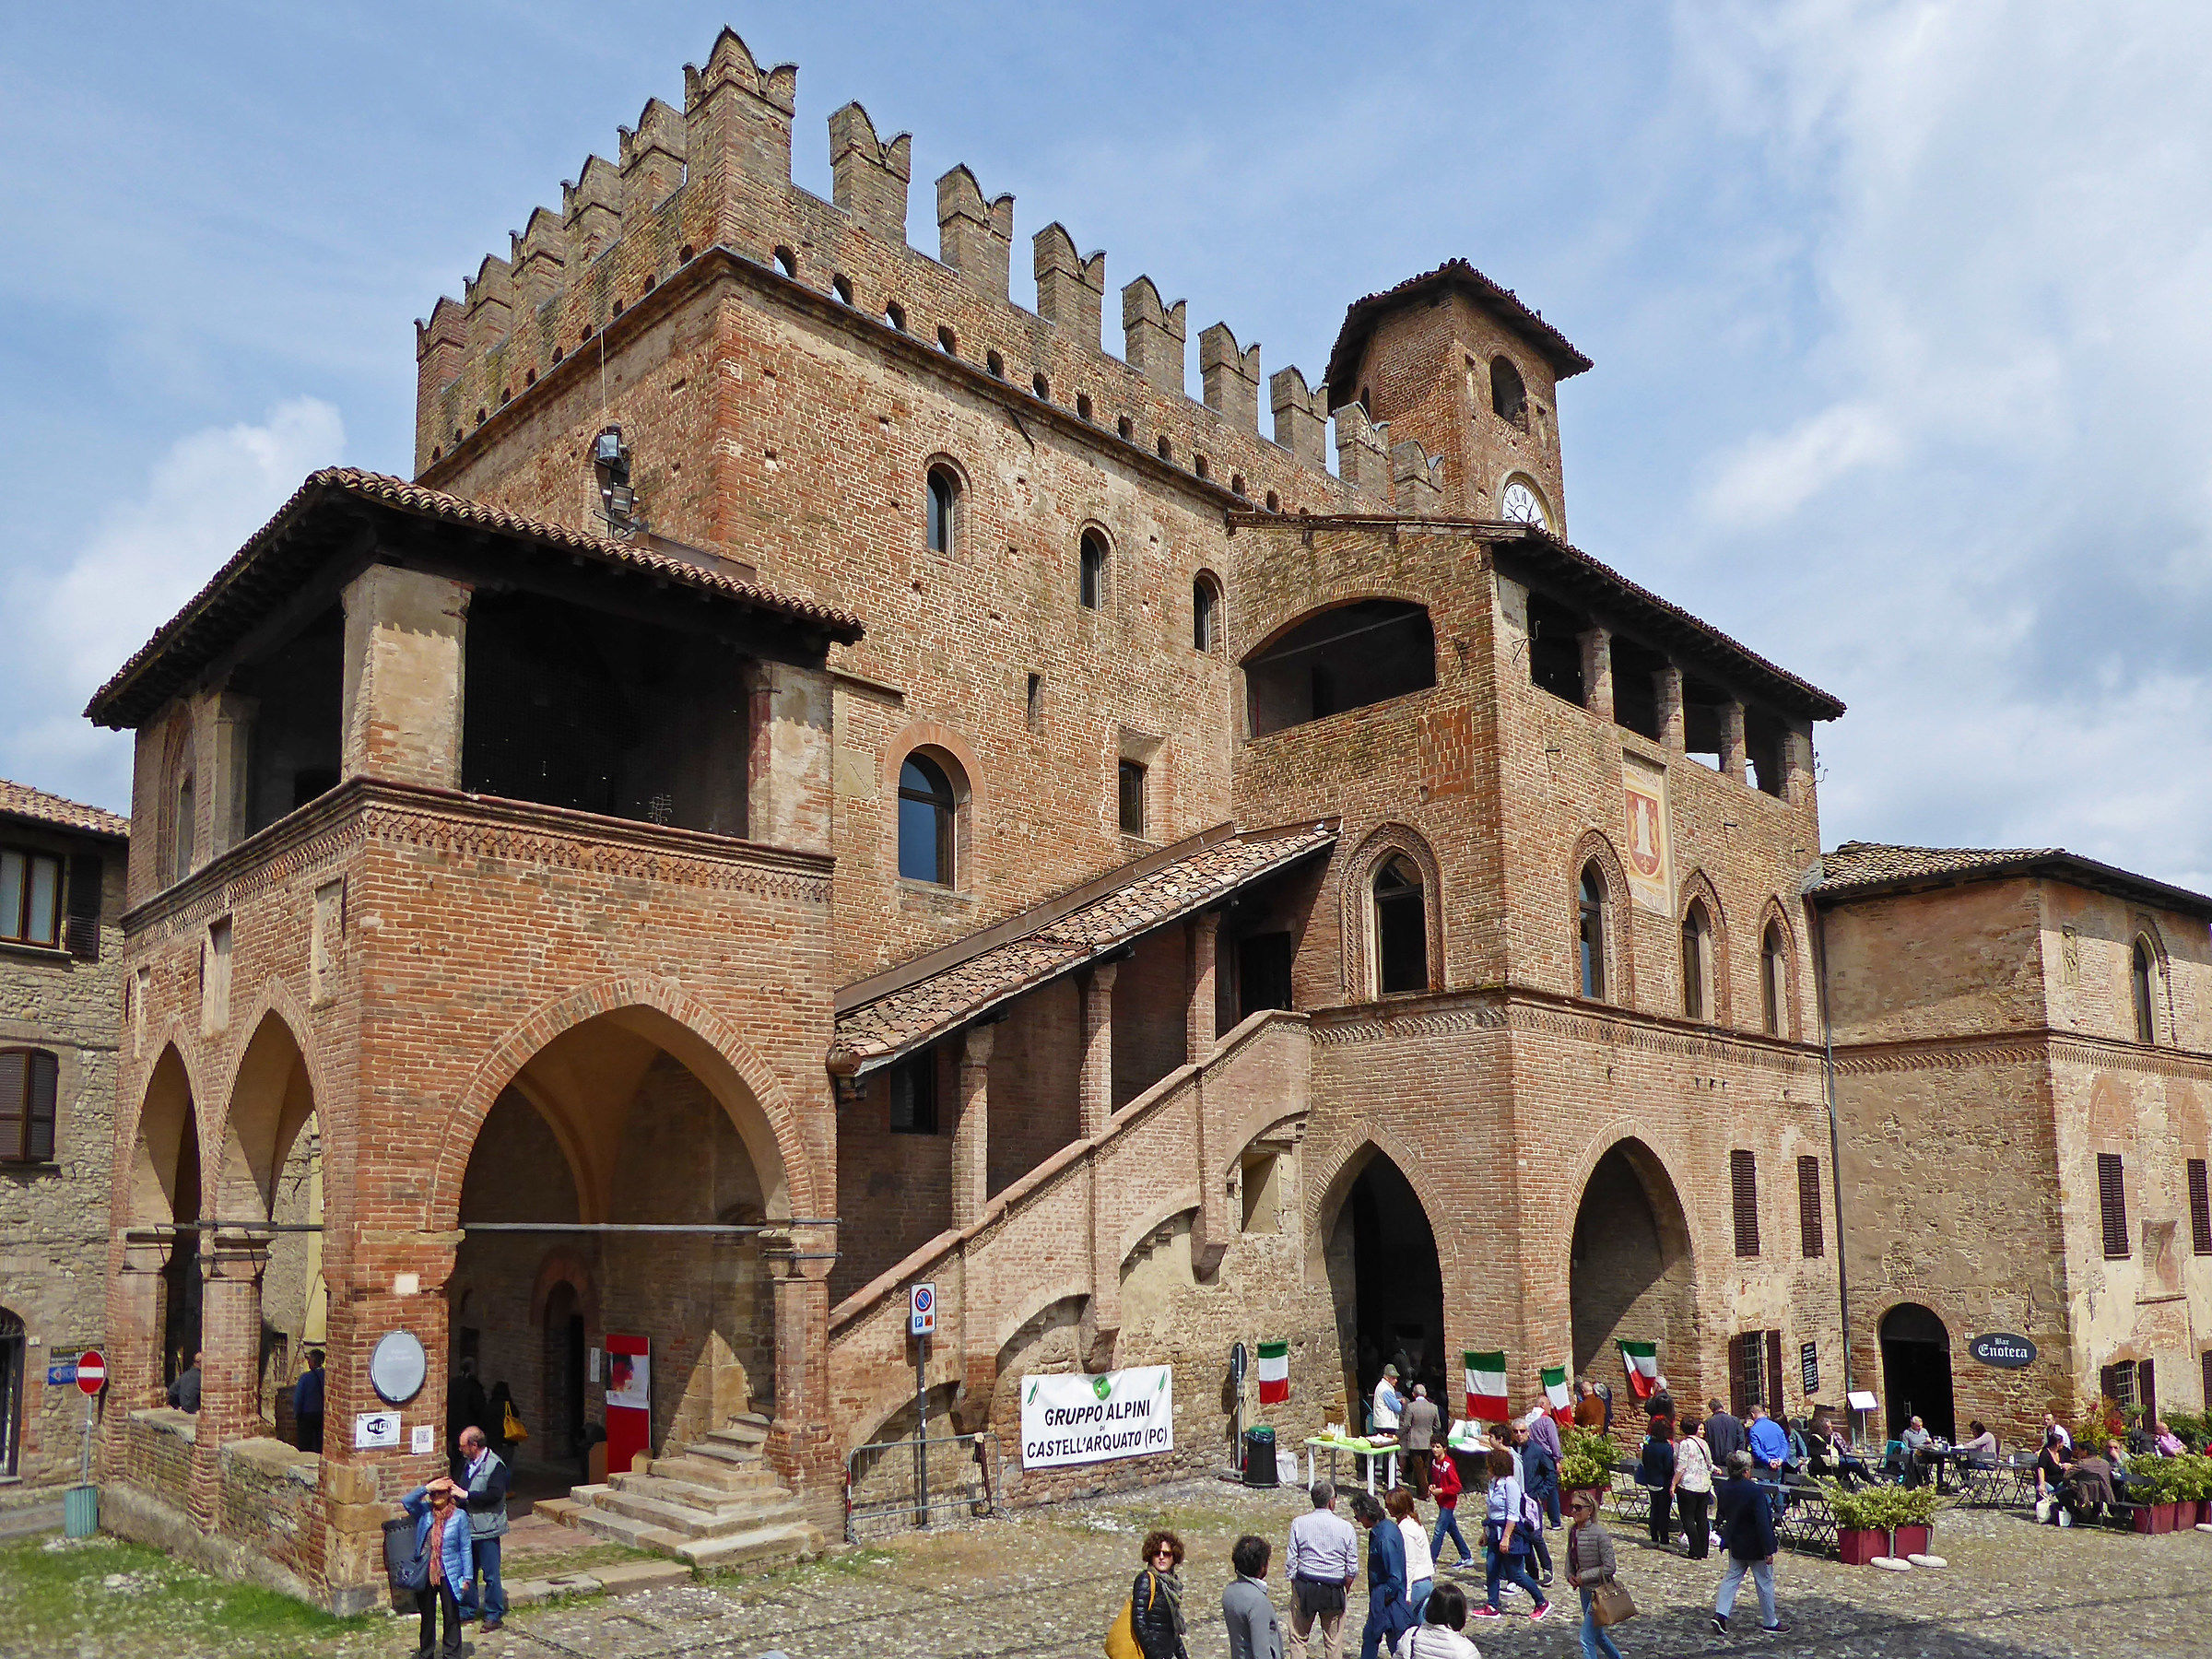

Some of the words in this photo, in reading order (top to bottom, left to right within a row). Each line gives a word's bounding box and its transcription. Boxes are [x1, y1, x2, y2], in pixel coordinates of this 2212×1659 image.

[1978, 1344, 2029, 1359] Enoteca
[1994, 1337, 2009, 1346] Bar
[1044, 1404, 1103, 1427] GRUPPO
[1105, 1399, 1150, 1421] ALPINI
[1027, 1430, 1142, 1459] CASTELL'ARQUATO
[1145, 1426, 1168, 1449] (PC)
